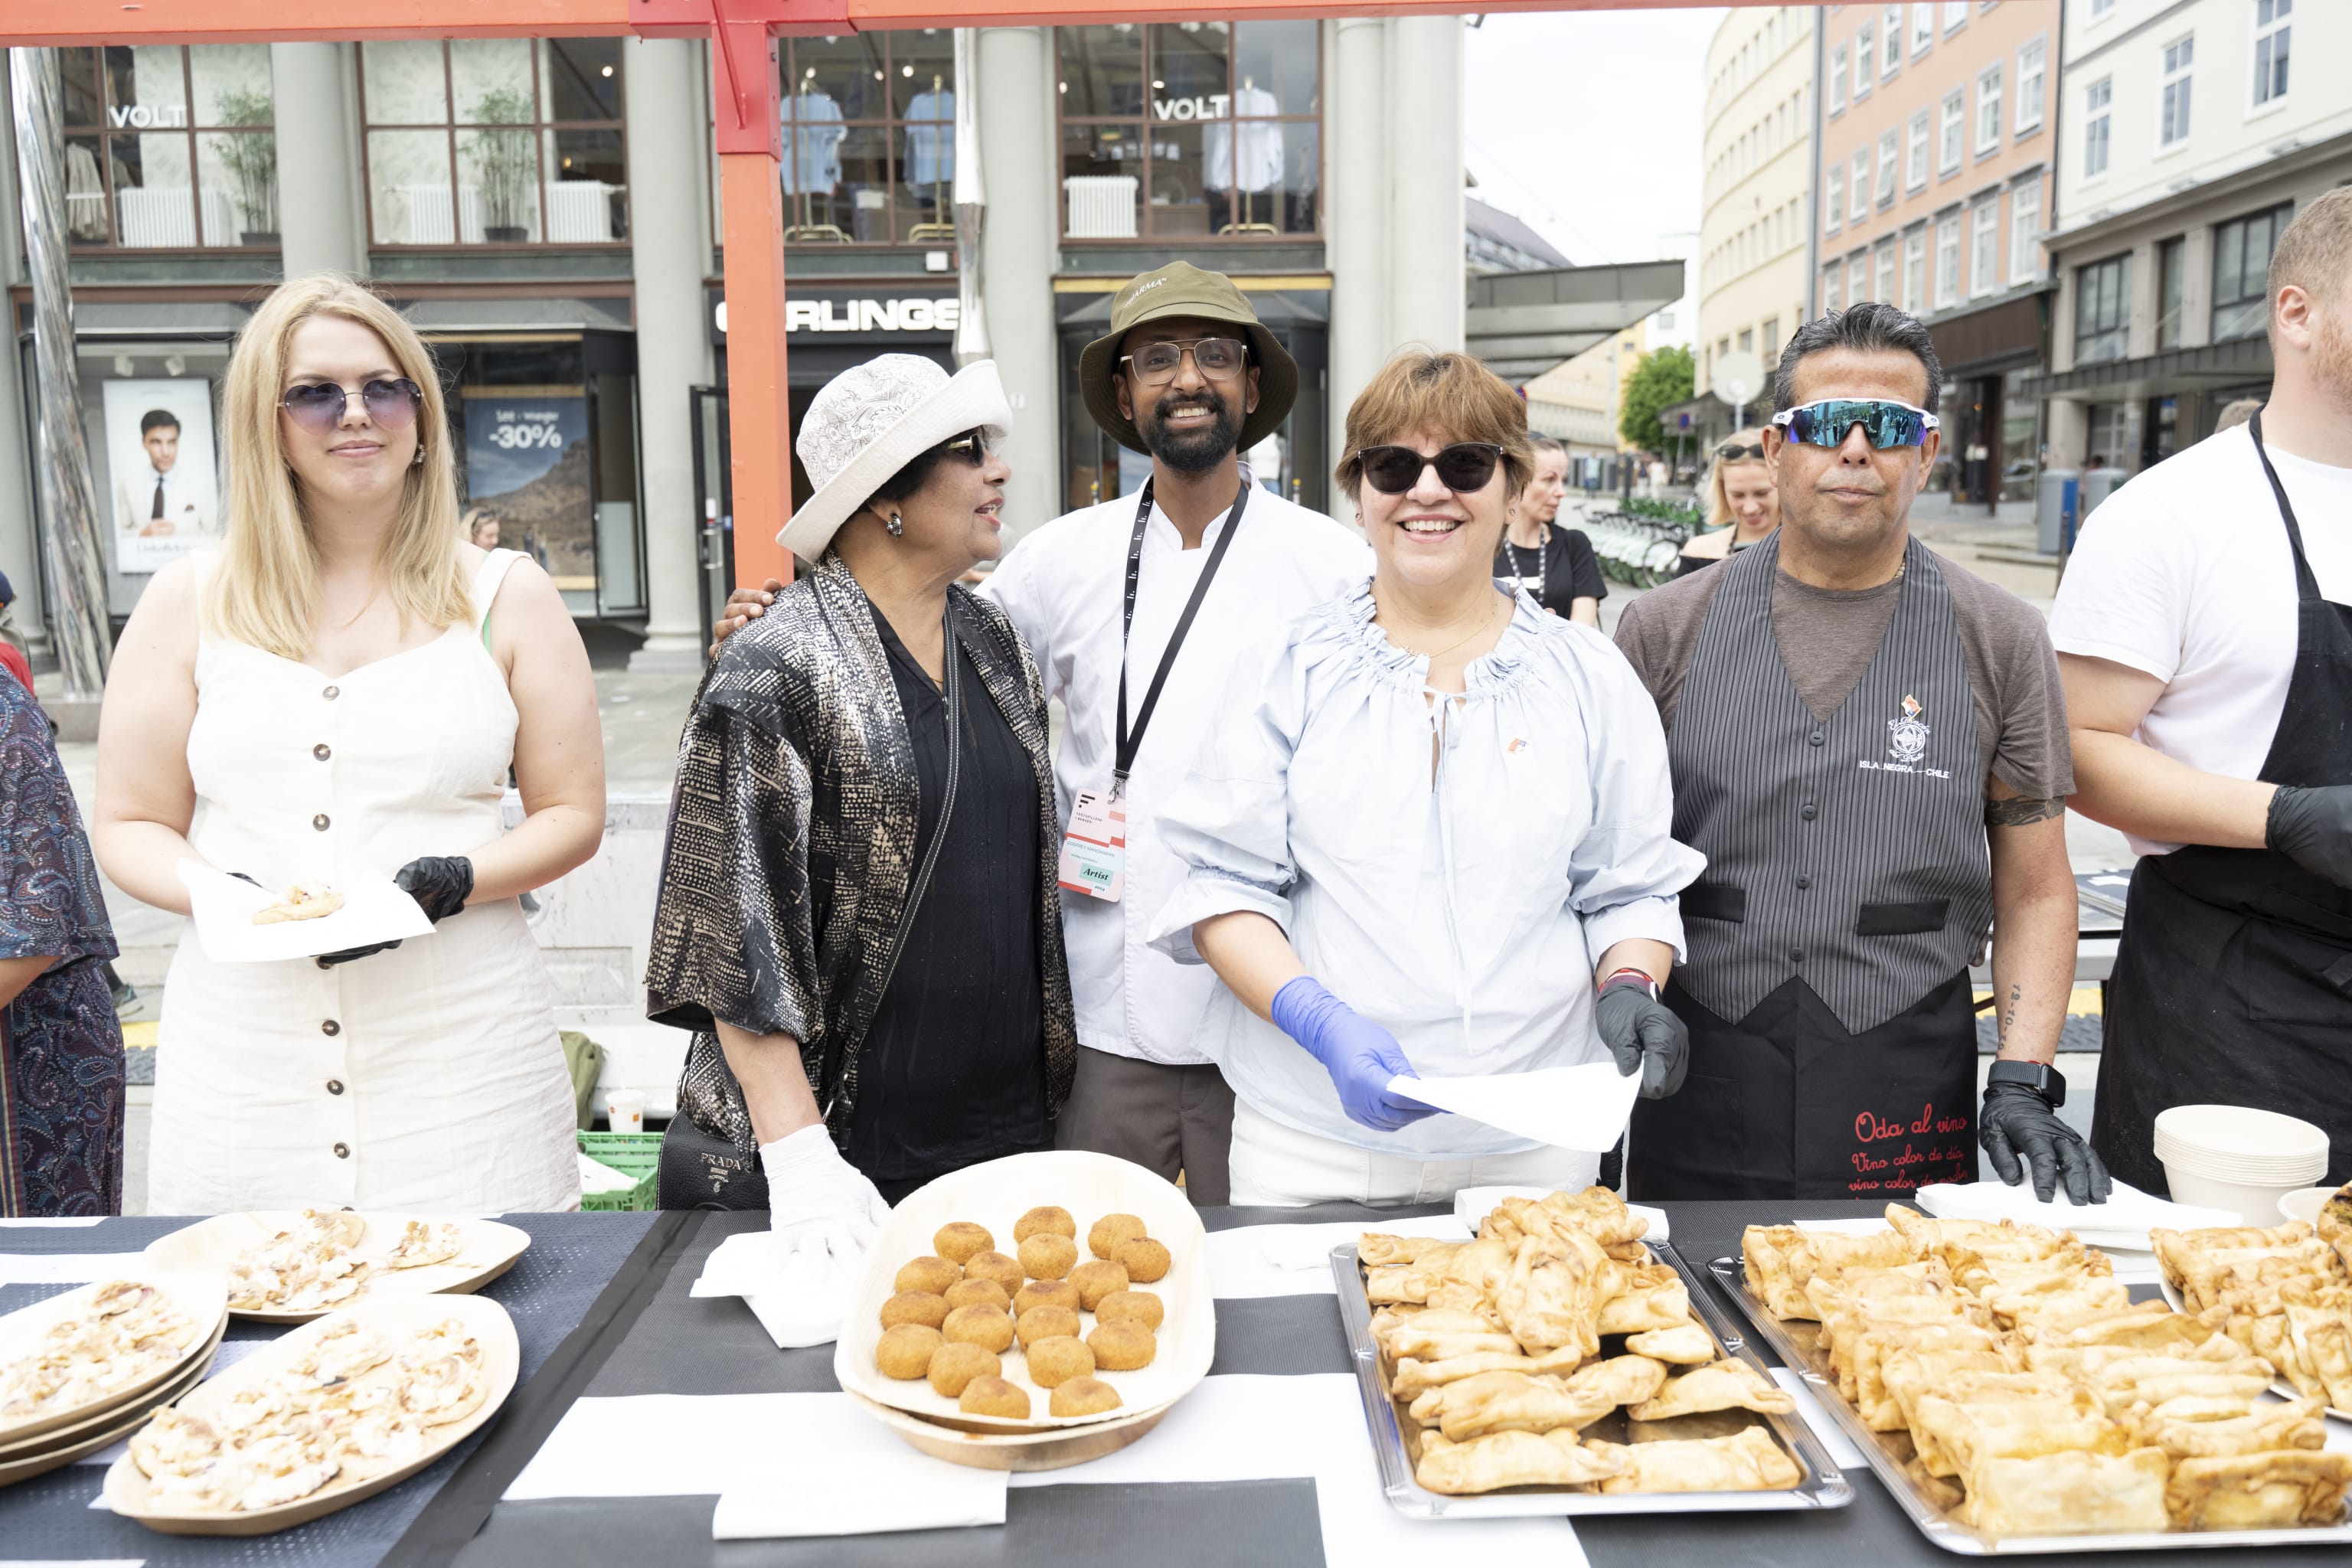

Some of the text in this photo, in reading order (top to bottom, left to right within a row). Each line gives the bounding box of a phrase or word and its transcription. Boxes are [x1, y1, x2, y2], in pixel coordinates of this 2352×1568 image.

[109, 105, 186, 129] VOLT
[1154, 94, 1230, 121] VOLT
[715, 299, 961, 332] RLINGS
[488, 425, 562, 449] -30%
[1859, 760, 1880, 769] ISLA
[1883, 763, 1913, 773] NEGRA
[1926, 768, 1949, 779] CHILE
[1083, 867, 1109, 880] Artist
[1855, 1103, 1968, 1142] Oda al vino
[701, 1152, 741, 1171] PRADA
[1851, 1152, 1889, 1172] Vino
[1893, 1144, 1926, 1166] color
[1929, 1147, 1942, 1161] de
[1848, 1178, 1880, 1191] vino
[1884, 1169, 1916, 1189] color
